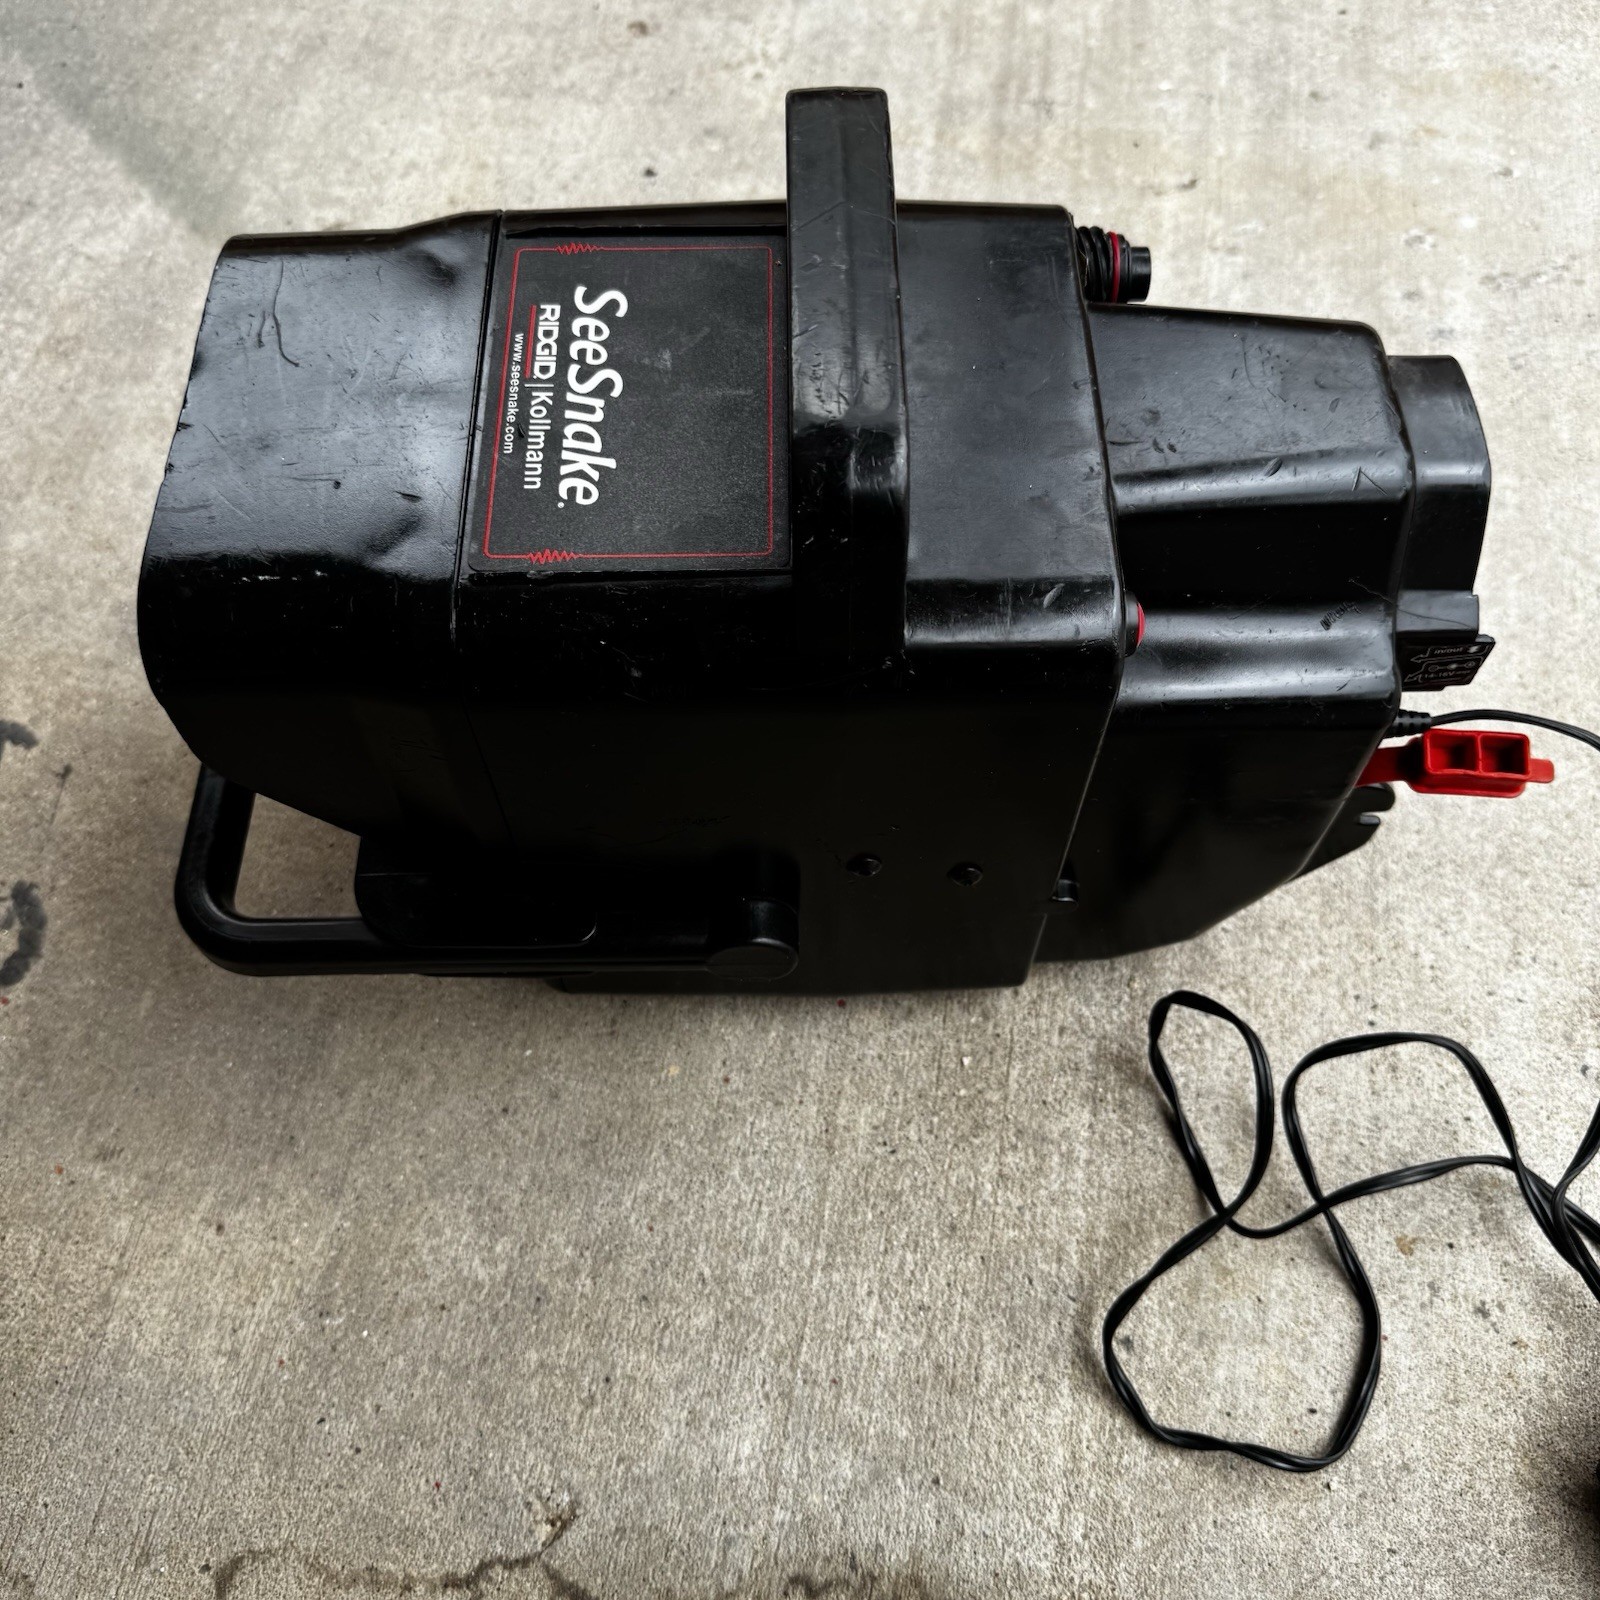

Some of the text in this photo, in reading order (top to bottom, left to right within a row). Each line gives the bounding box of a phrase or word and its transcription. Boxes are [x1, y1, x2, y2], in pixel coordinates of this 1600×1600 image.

[503, 333, 524, 454] www.seesnake.com
[523, 304, 561, 490] RIDGID Kollmann
[558, 283, 628, 506] SeeSnake
